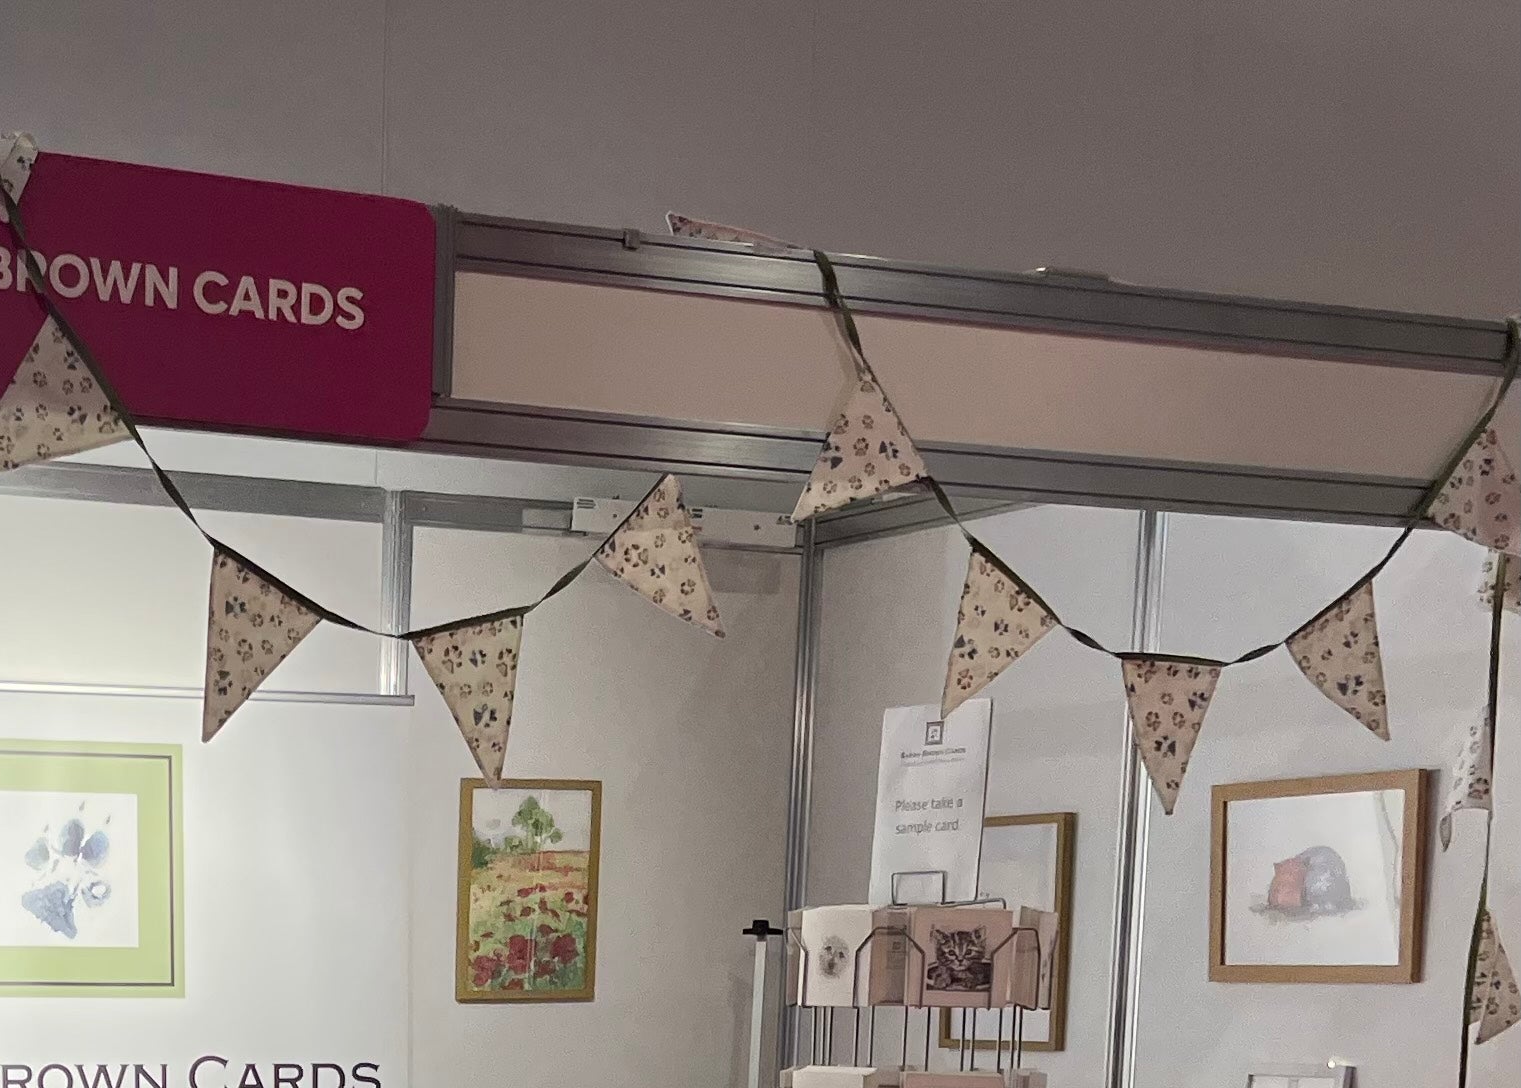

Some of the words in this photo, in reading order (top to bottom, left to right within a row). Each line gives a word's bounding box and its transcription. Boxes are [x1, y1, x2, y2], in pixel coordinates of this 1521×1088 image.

[193, 270, 365, 331] CARDS
[895, 800, 927, 812] Please
[931, 798, 954, 809] take
[895, 820, 932, 836] sample
[935, 819, 959, 832] card
